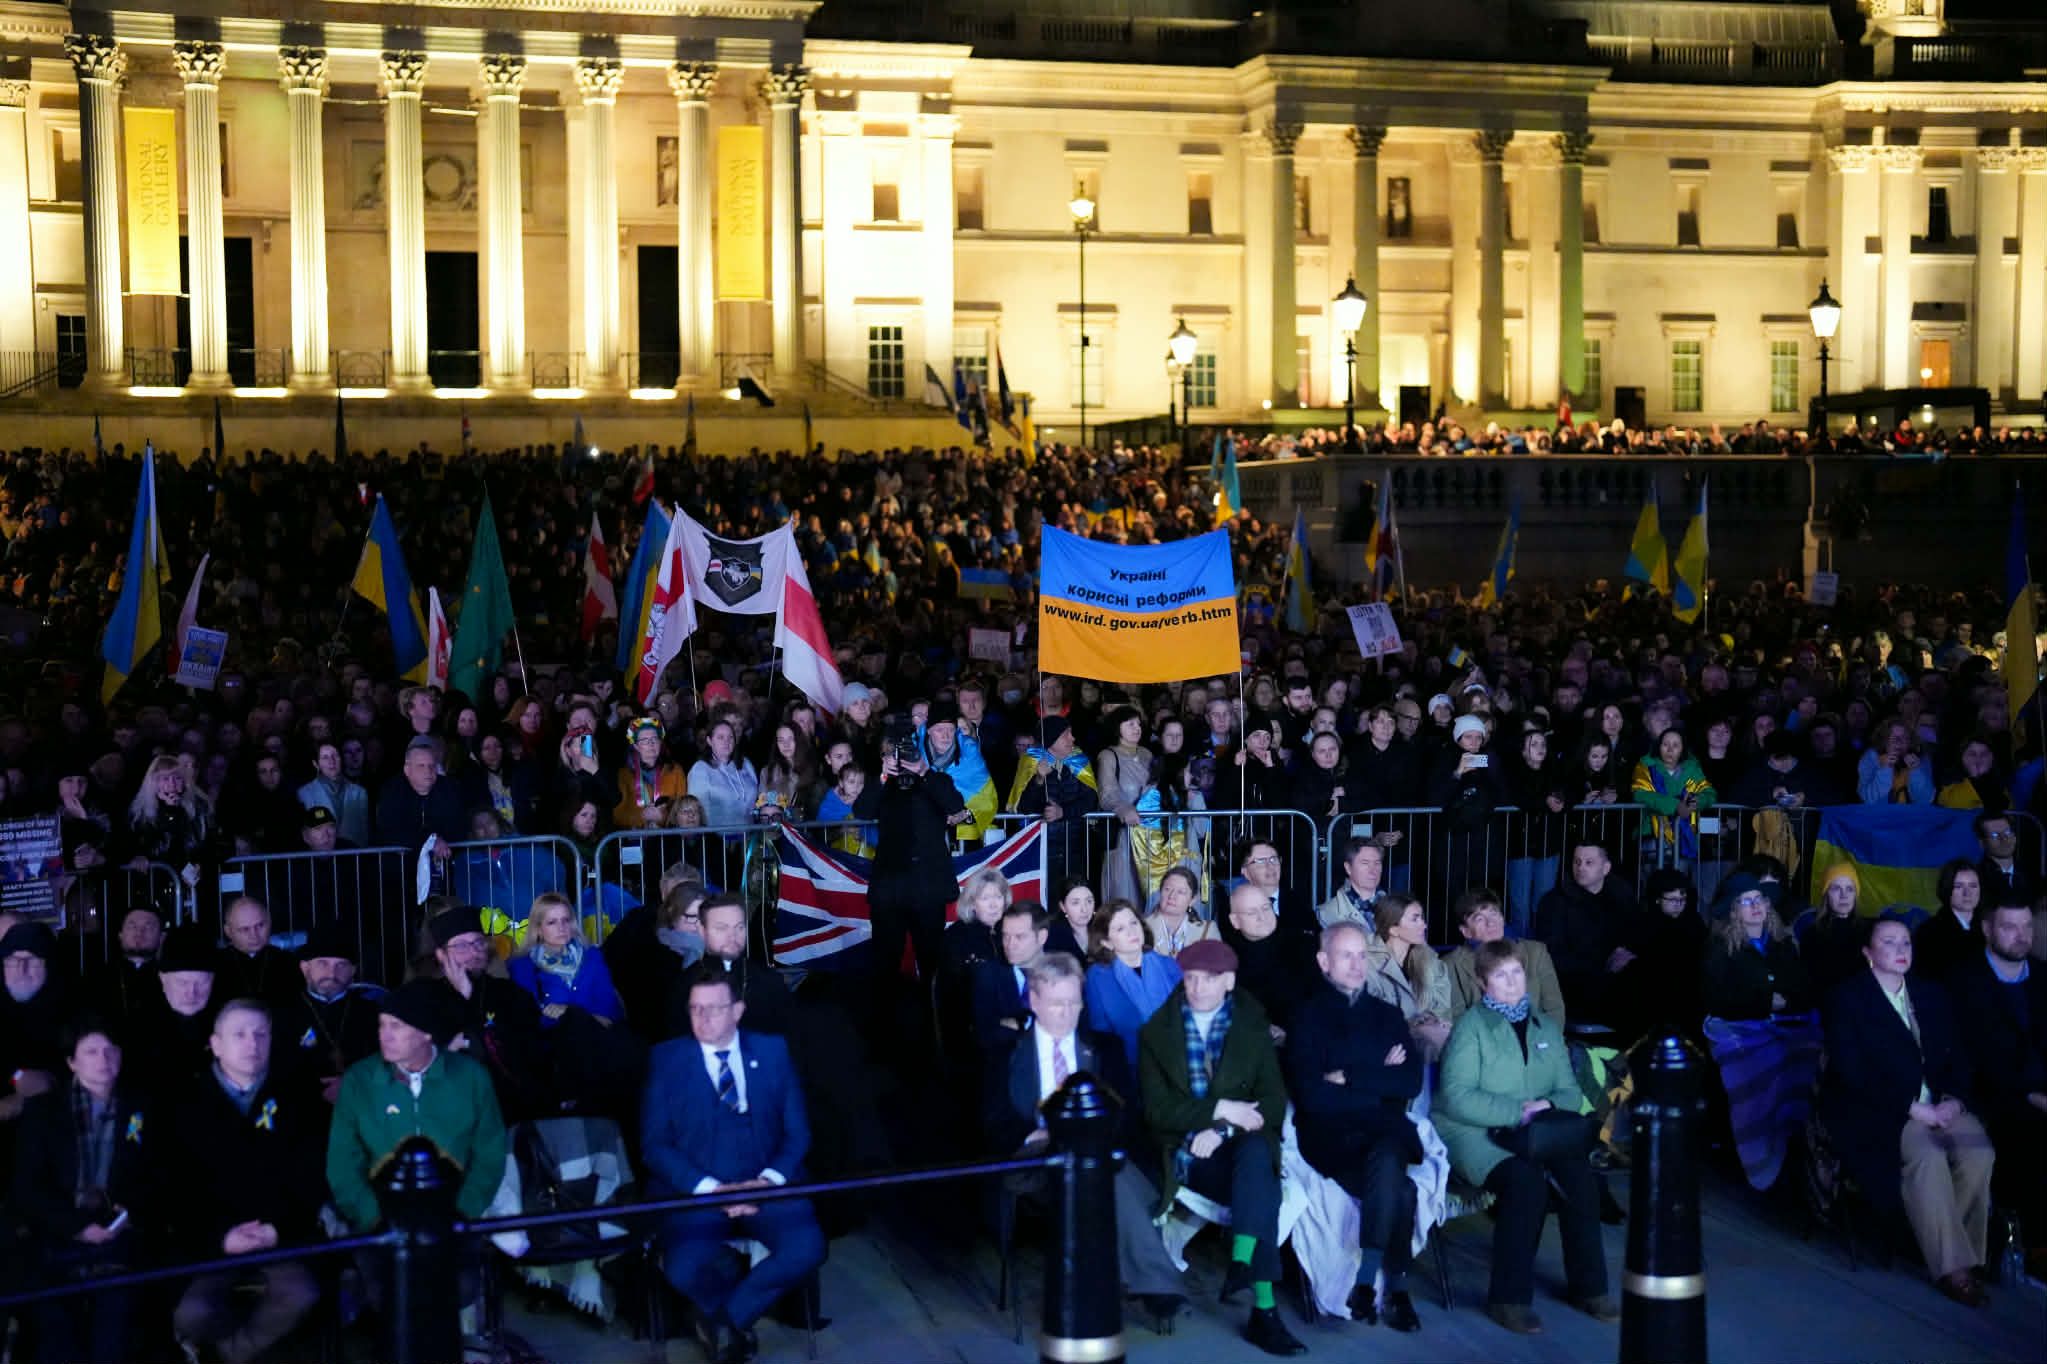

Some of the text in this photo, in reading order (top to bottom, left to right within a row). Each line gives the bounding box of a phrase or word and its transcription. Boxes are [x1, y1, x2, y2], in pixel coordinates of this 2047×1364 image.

[1110, 568, 1166, 583] Україні
[1067, 584, 1206, 608] корисні реформи
